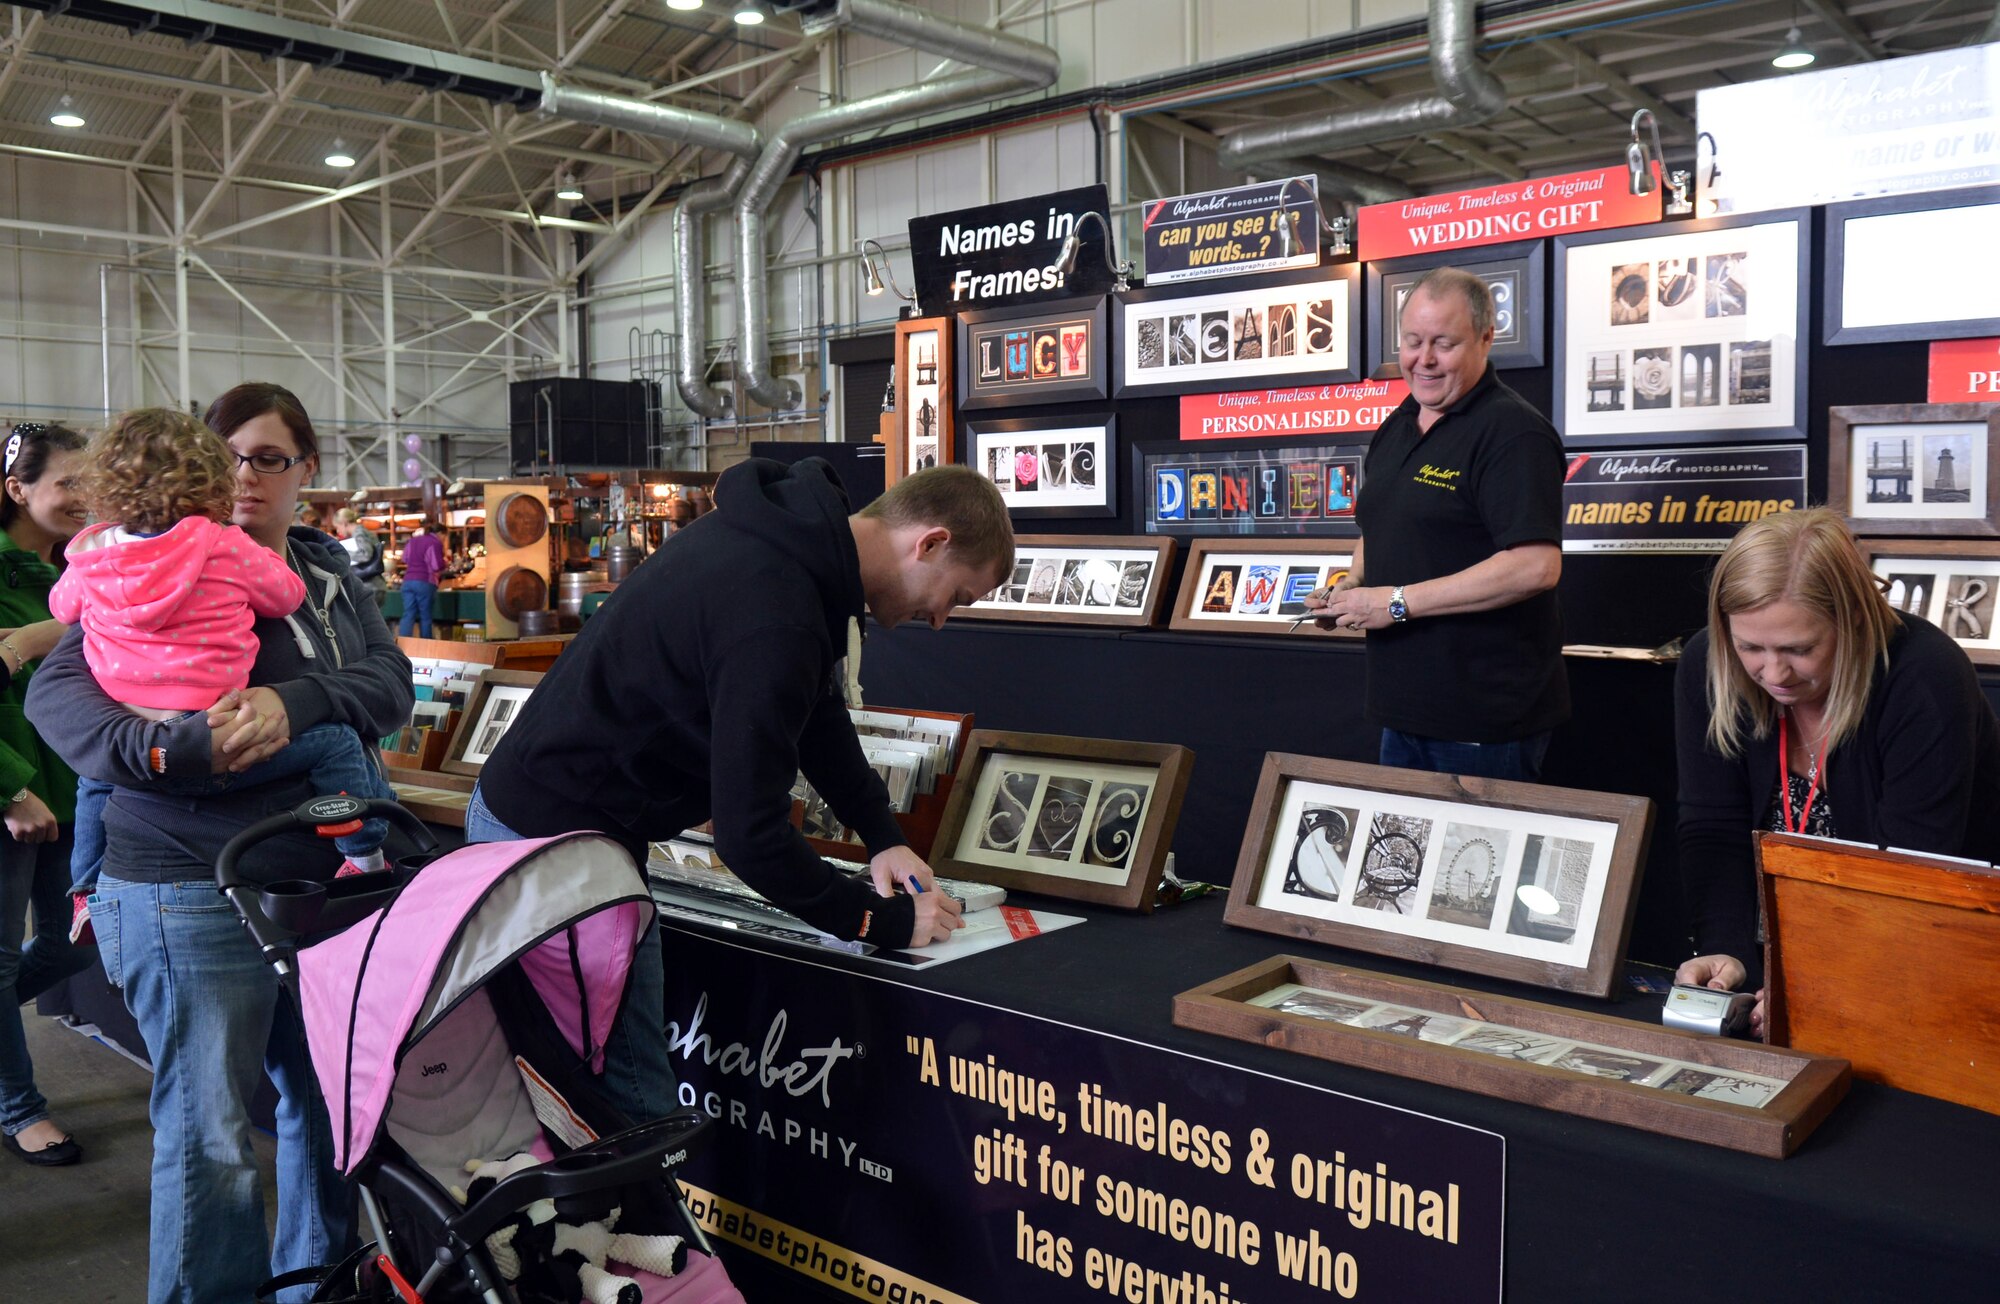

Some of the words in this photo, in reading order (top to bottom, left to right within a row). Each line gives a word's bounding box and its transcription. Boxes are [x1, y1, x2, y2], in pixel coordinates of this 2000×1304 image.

[1933, 135, 1965, 159] or
[1973, 131, 2000, 154] w
[1173, 195, 1229, 220] Alphabet
[1227, 194, 1280, 208] PHOTOGRAPH
[1401, 201, 1453, 221] Unique,
[1458, 189, 1518, 211] Timeless
[1521, 184, 1536, 201] &
[1540, 173, 1605, 200] Original
[940, 218, 1035, 257] Names
[1047, 207, 1074, 240] in
[1159, 226, 1191, 248] can
[1195, 221, 1228, 249] you
[1231, 215, 1265, 238] see
[1408, 210, 1531, 248] WEDDING
[1538, 200, 1604, 229] GIFT
[1189, 235, 1271, 266] words...?
[1170, 260, 1289, 280] www.alphabetphotography.co.uk
[1217, 393, 1262, 410] Unique,
[1266, 387, 1316, 404] Timeless
[1319, 385, 1331, 400] &
[1334, 381, 1390, 402] Original
[1201, 408, 1351, 435] PERSONALISED
[1599, 456, 1679, 482] Alphabet
[1676, 464, 1758, 474] PHOTOGRAPHY
[1565, 501, 1653, 525] names
[1658, 495, 1688, 524] in
[421, 1062, 448, 1077] Jeep
[678, 1082, 857, 1167] OGRAPHY
[861, 1158, 891, 1181] LTD
[661, 1149, 687, 1168] Jeep
[950, 1054, 1067, 1134] unique,
[1078, 1082, 1232, 1175] timeless
[1246, 1127, 1276, 1188] &
[1291, 1150, 1459, 1245] original
[974, 1128, 1028, 1188] gift
[1038, 1144, 1085, 1206] for
[1096, 1174, 1261, 1266] someone
[1274, 1228, 1358, 1299] who
[1016, 1209, 1073, 1278] has
